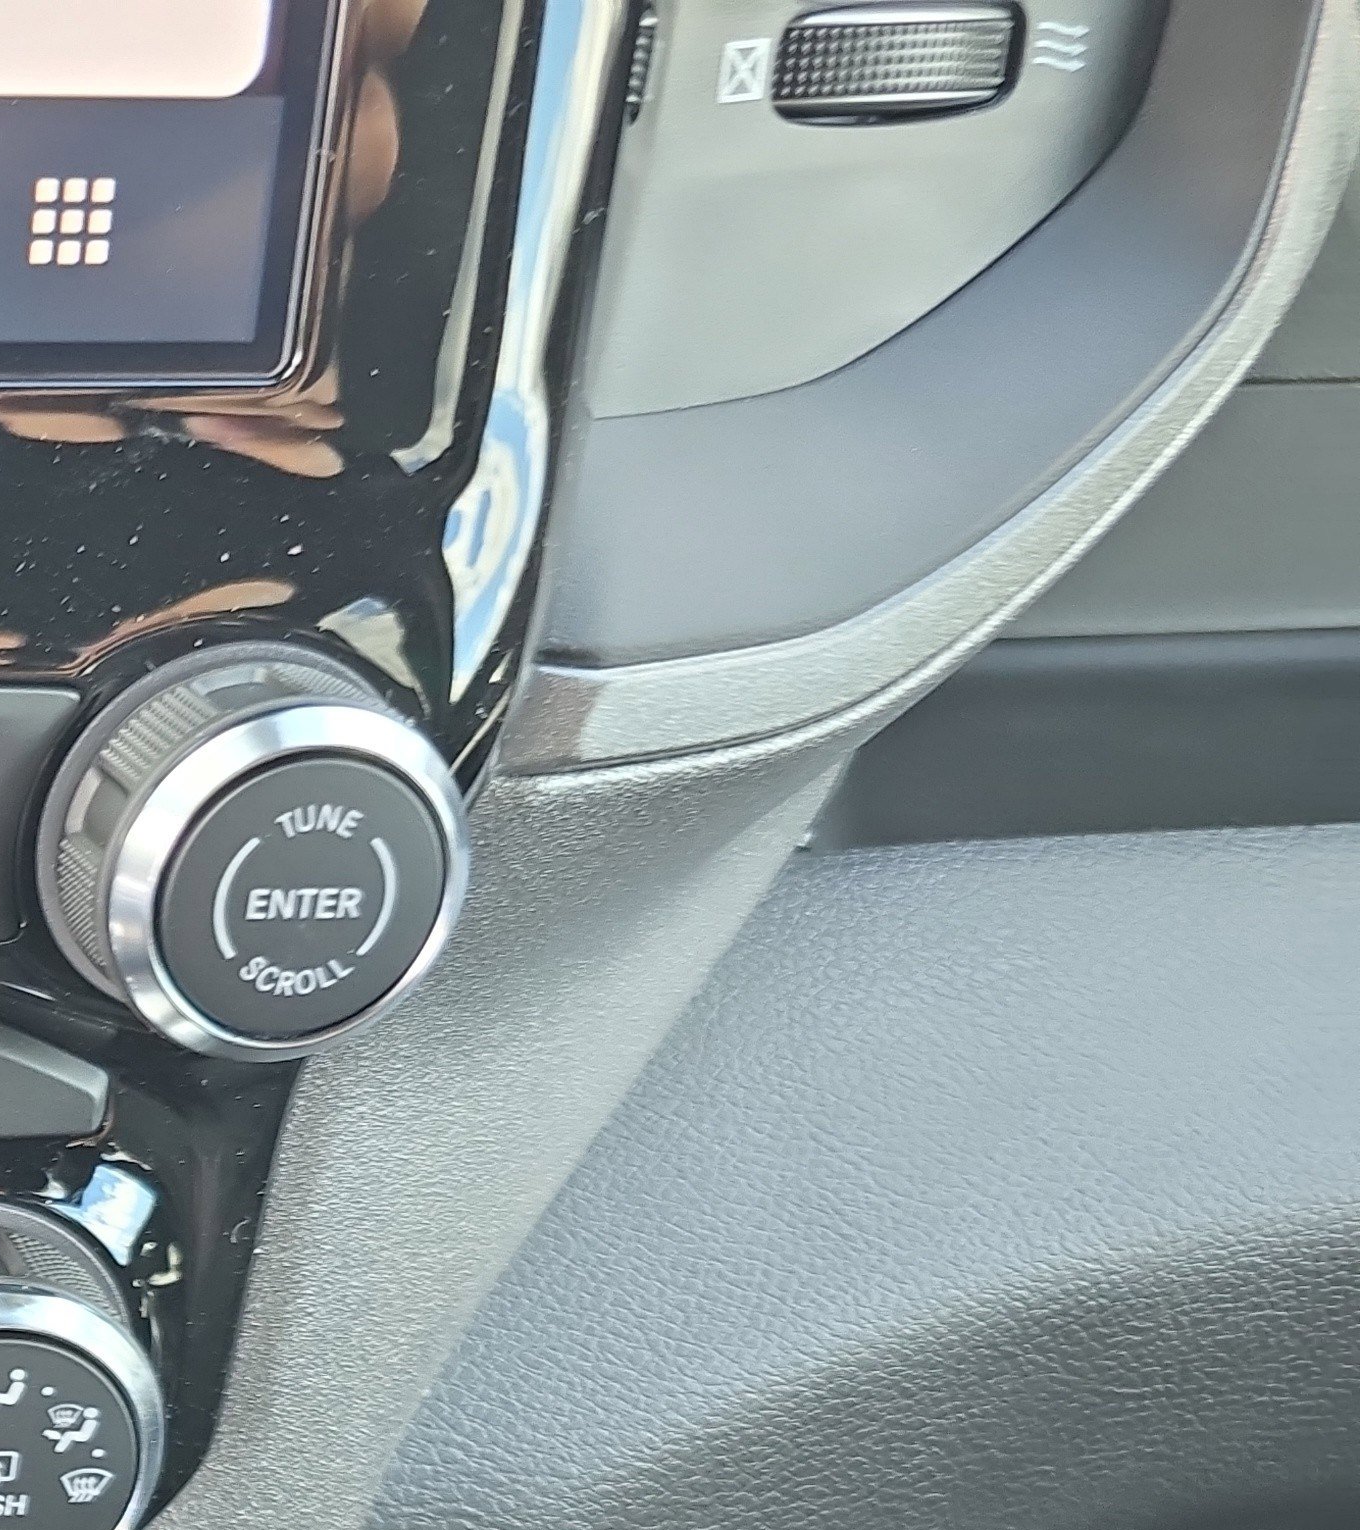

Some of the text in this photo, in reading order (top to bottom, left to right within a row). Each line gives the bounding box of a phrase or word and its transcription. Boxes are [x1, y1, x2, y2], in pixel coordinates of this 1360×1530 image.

[275, 804, 365, 840] TUNE
[244, 887, 363, 921] ENTER
[238, 954, 355, 998] SCROLL
